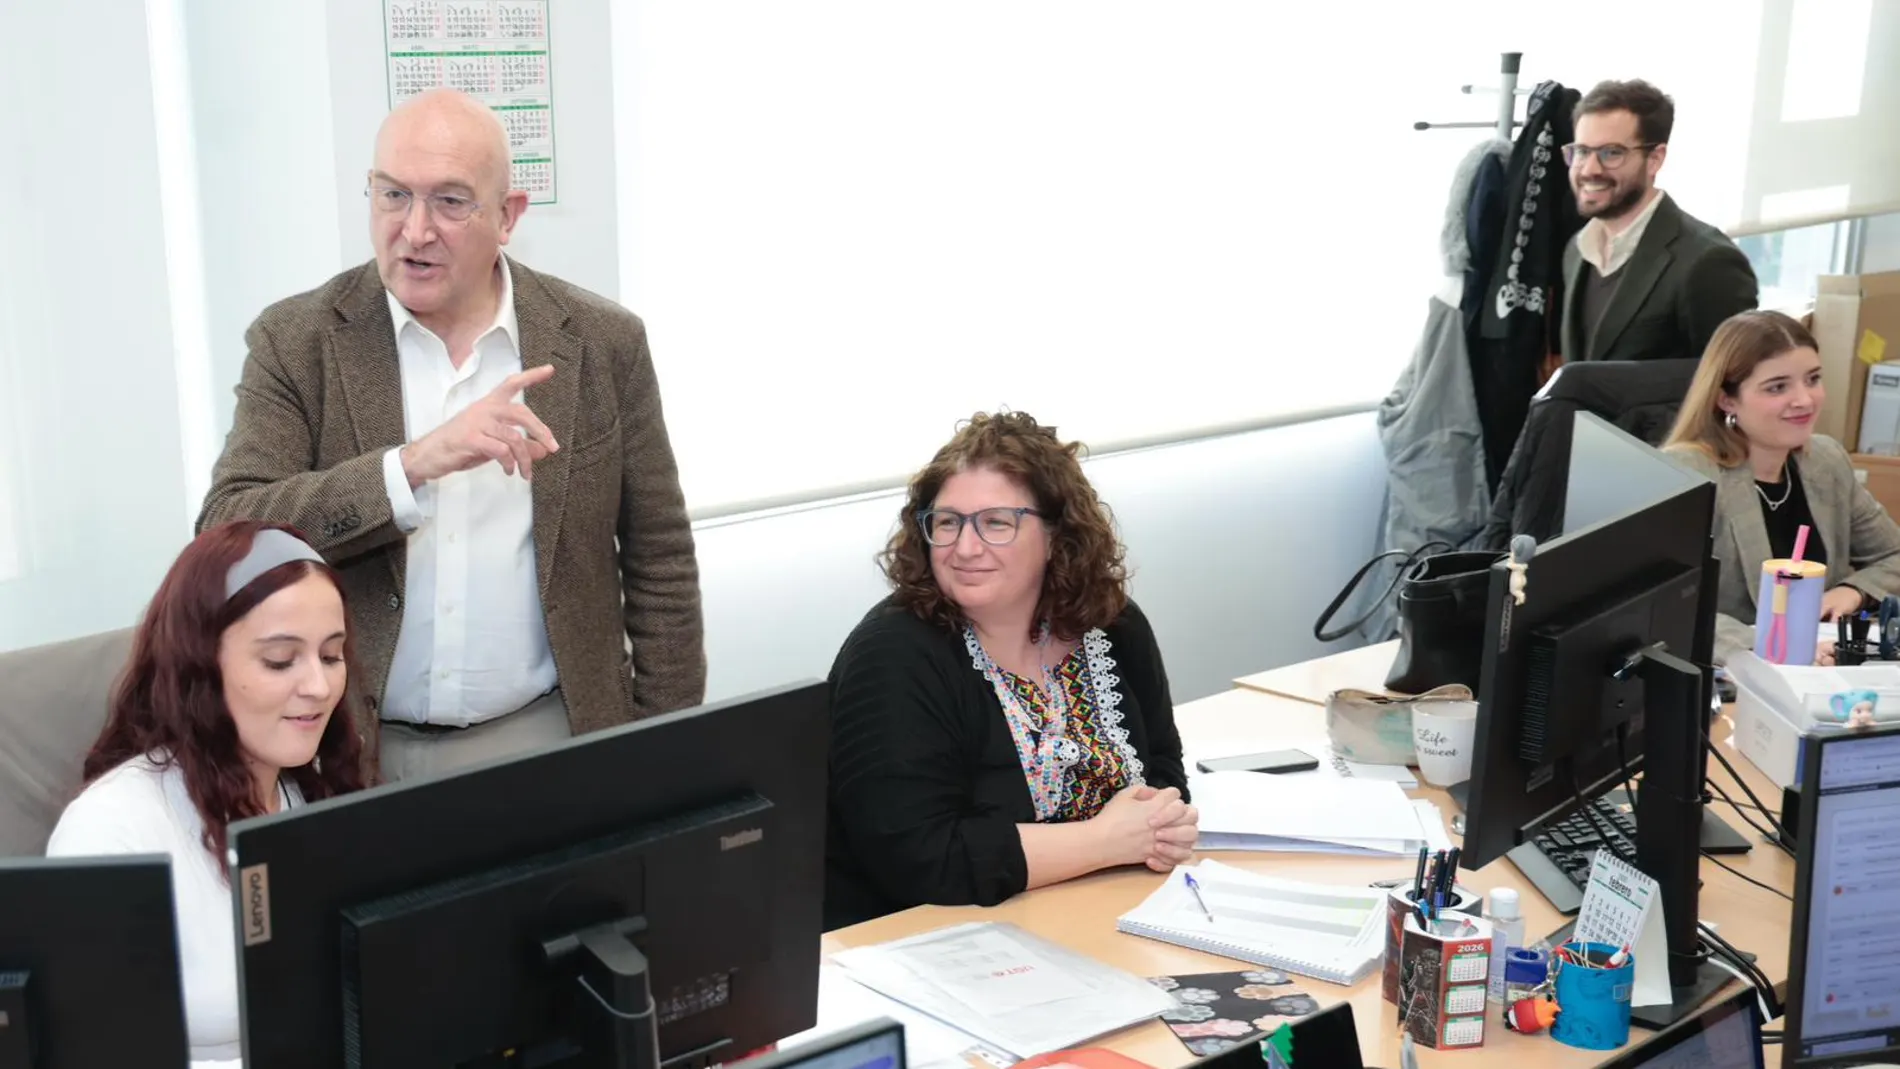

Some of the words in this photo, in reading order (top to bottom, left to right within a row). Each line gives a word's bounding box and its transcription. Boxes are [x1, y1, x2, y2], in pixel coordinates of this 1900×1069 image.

[1416, 728, 1448, 747] Life
[1424, 747, 1458, 757] sweet
[1609, 875, 1632, 897] febrero
[250, 872, 264, 938] Lenovo
[1457, 943, 1484, 953] 2026
